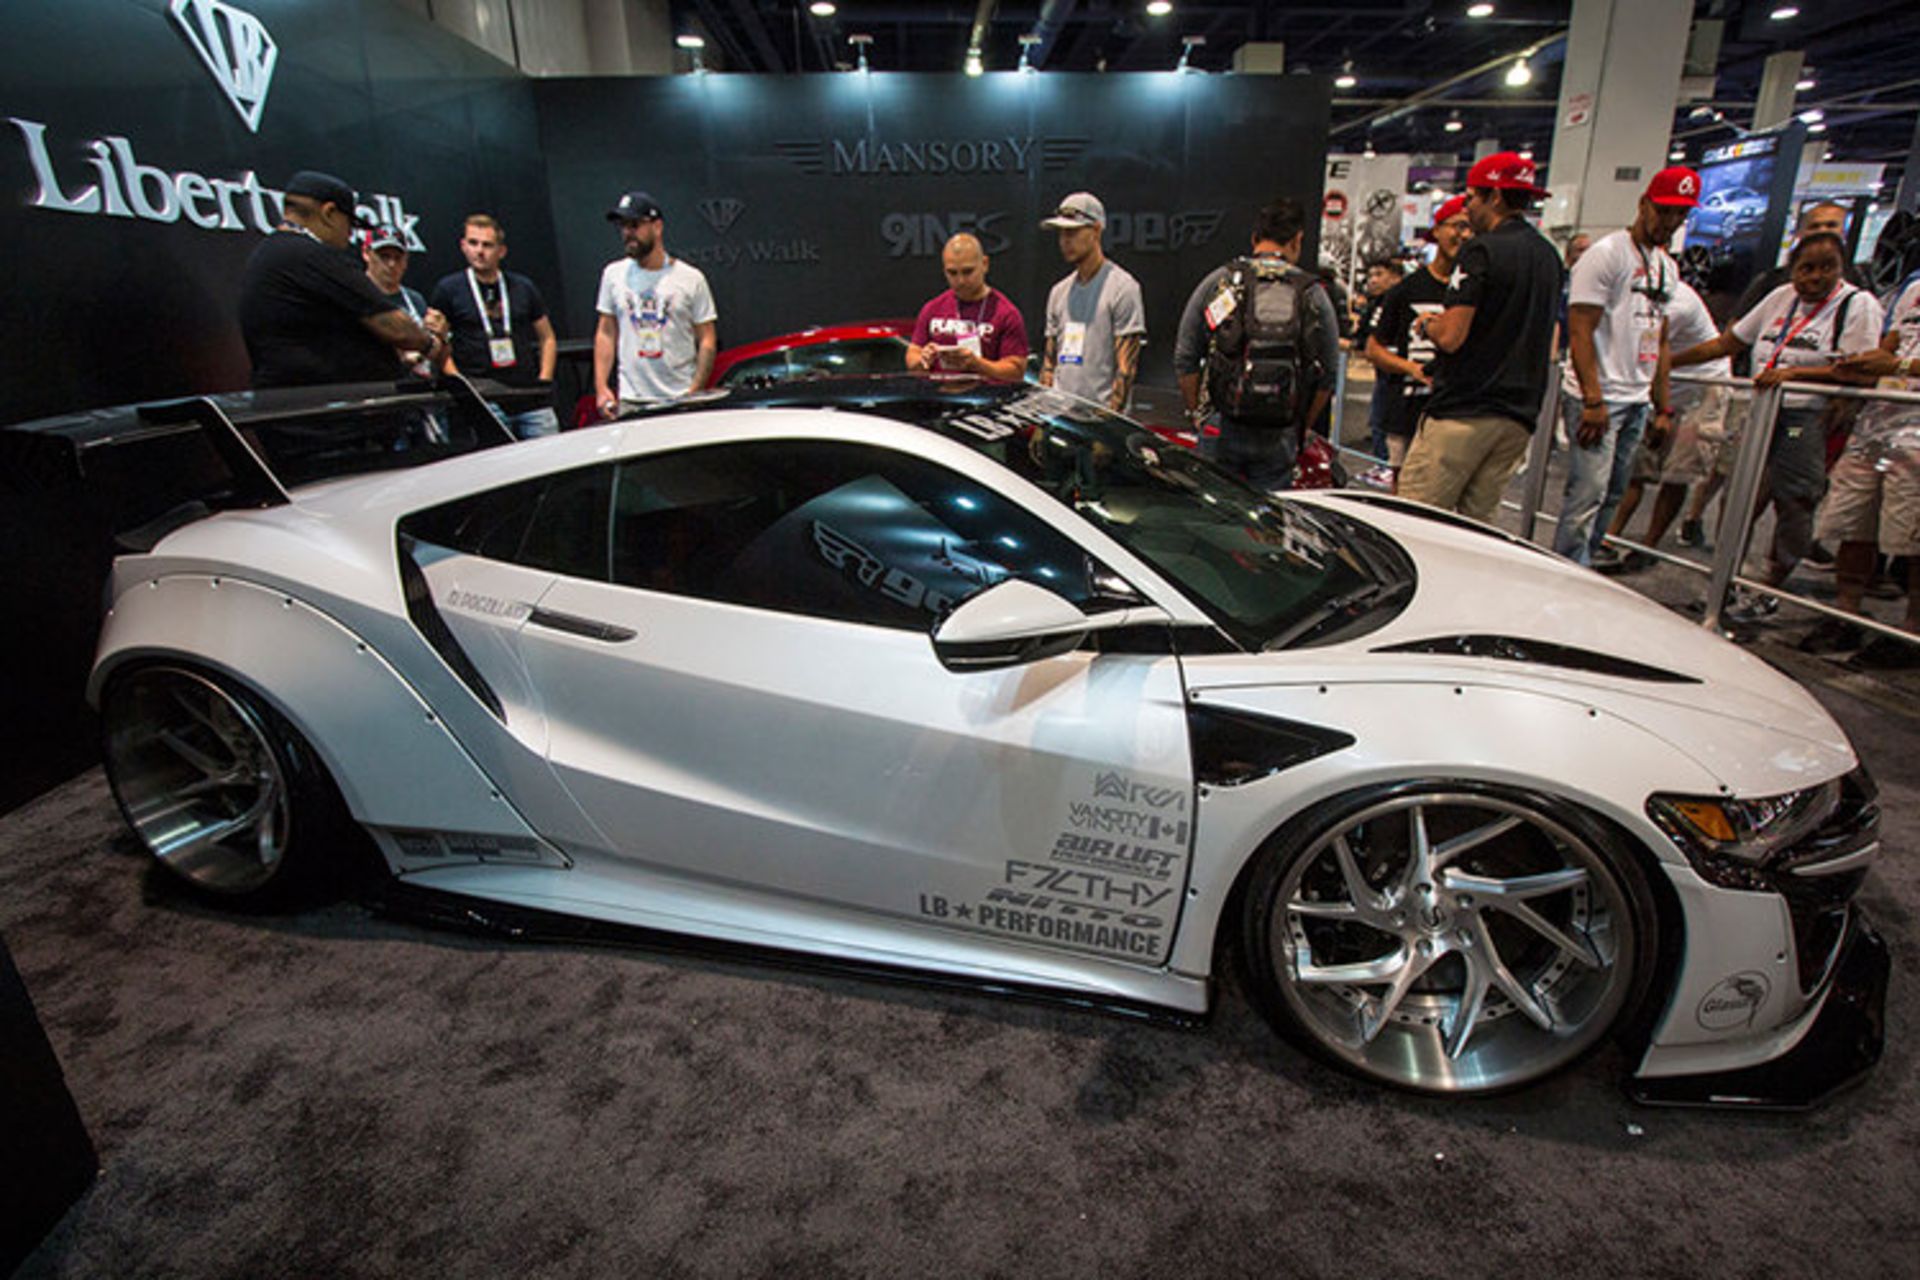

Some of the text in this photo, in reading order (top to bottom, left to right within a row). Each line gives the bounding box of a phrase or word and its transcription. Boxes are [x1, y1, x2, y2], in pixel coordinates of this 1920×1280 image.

[832, 136, 1034, 173] MANSORY
[350, 192, 427, 252] alk
[919, 893, 1161, 956] LB PERFORMANCE
